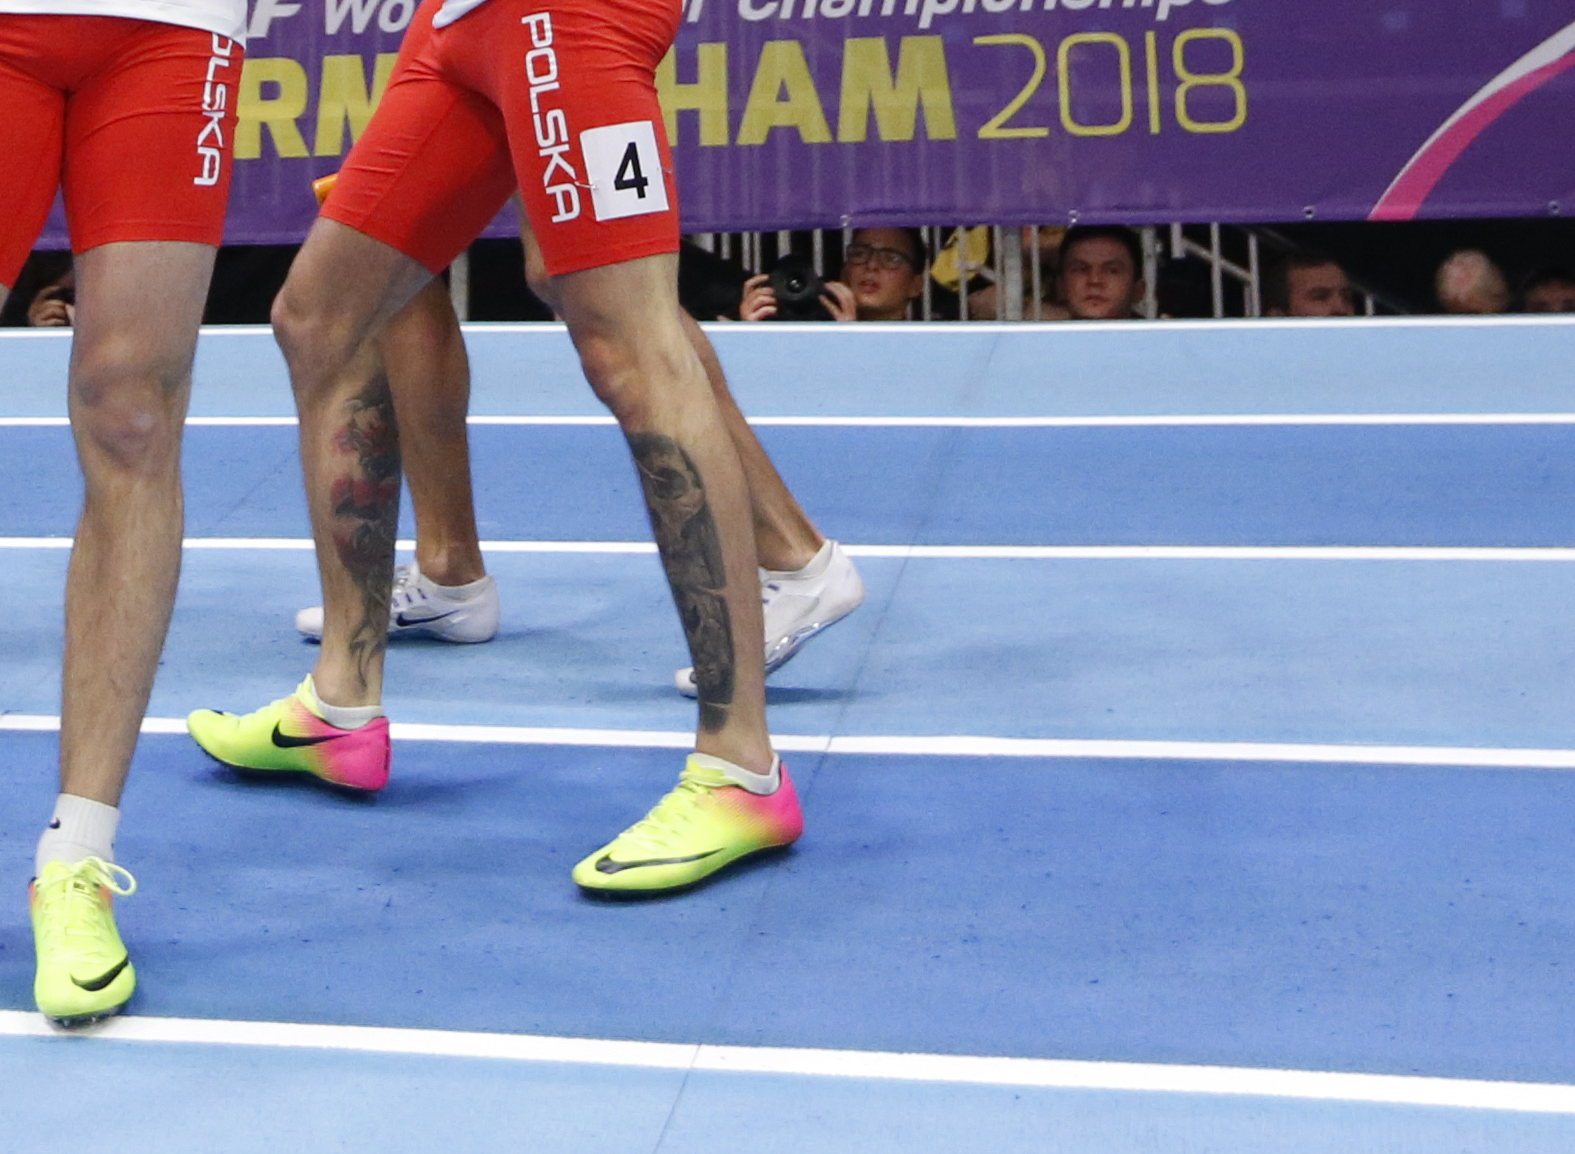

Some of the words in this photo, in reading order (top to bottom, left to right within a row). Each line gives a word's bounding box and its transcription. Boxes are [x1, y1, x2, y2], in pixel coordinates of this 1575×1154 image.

[193, 33, 234, 187] OLSKA
[522, 12, 582, 224] POLSKA
[973, 28, 1247, 139] 2018
[614, 141, 649, 199] 4
